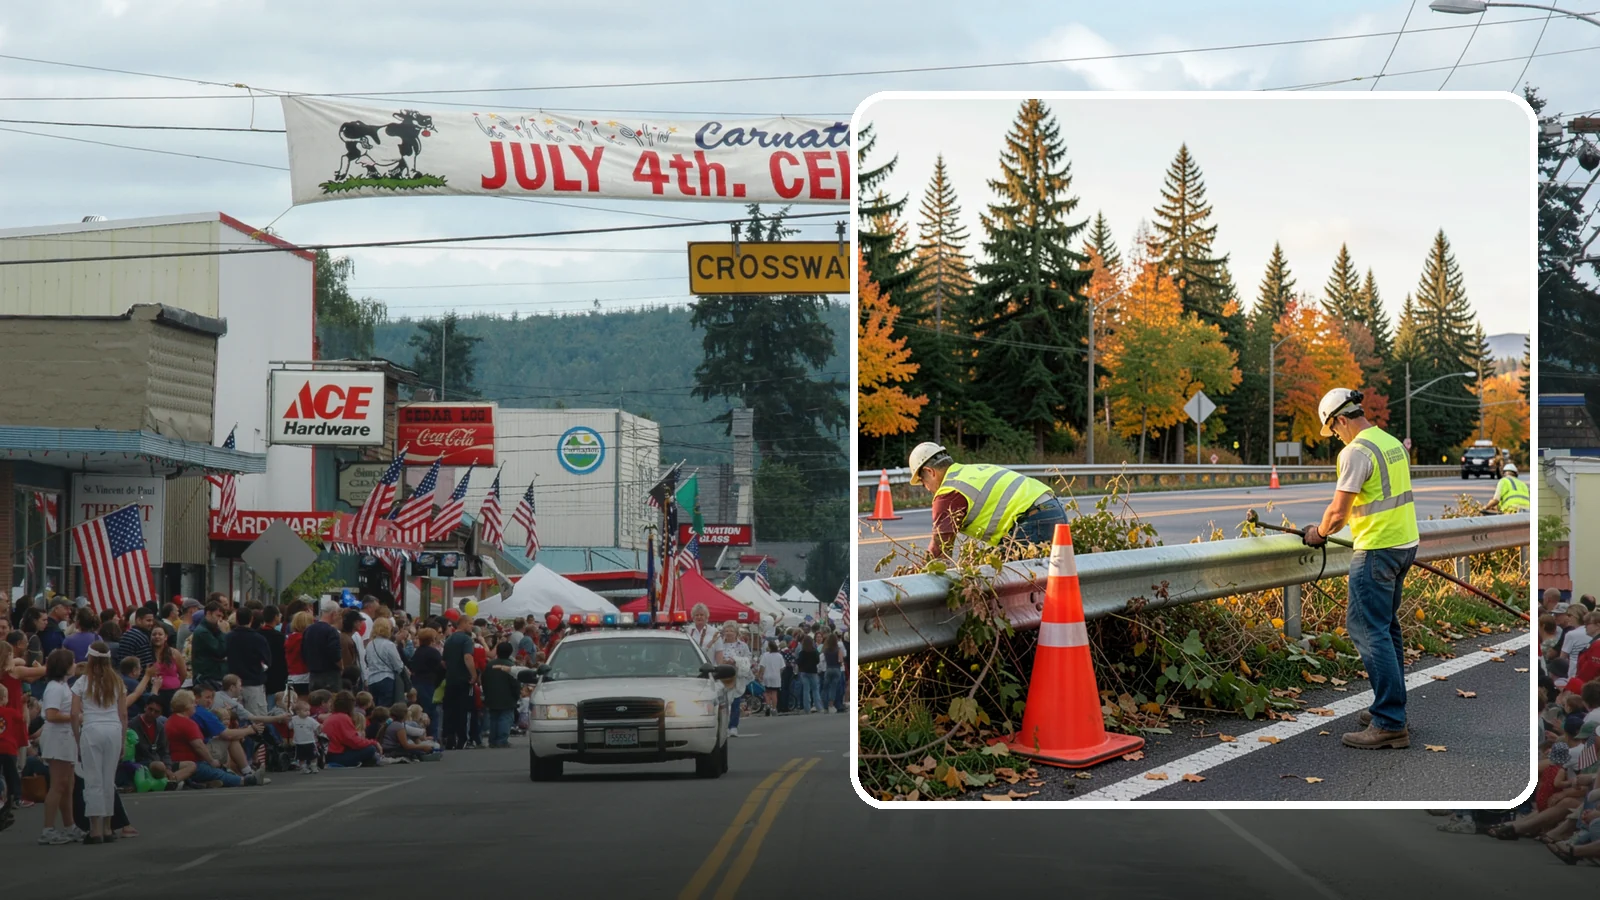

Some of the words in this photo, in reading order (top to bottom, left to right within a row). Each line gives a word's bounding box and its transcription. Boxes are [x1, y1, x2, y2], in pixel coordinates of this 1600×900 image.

[481, 141, 605, 192] JULY
[632, 150, 746, 198] 4th.
[697, 254, 850, 280] CROSSWA
[283, 380, 374, 420] ACE
[405, 409, 453, 421] CEDAR
[283, 421, 371, 436] Hardware
[416, 428, 477, 447] Coca-Cola
[96, 485, 124, 494] Vincent
[126, 485, 135, 494] de
[138, 486, 155, 495] Paul
[81, 503, 154, 522] THT
[688, 526, 741, 535] CRNATION
[699, 535, 730, 543] GLASS
